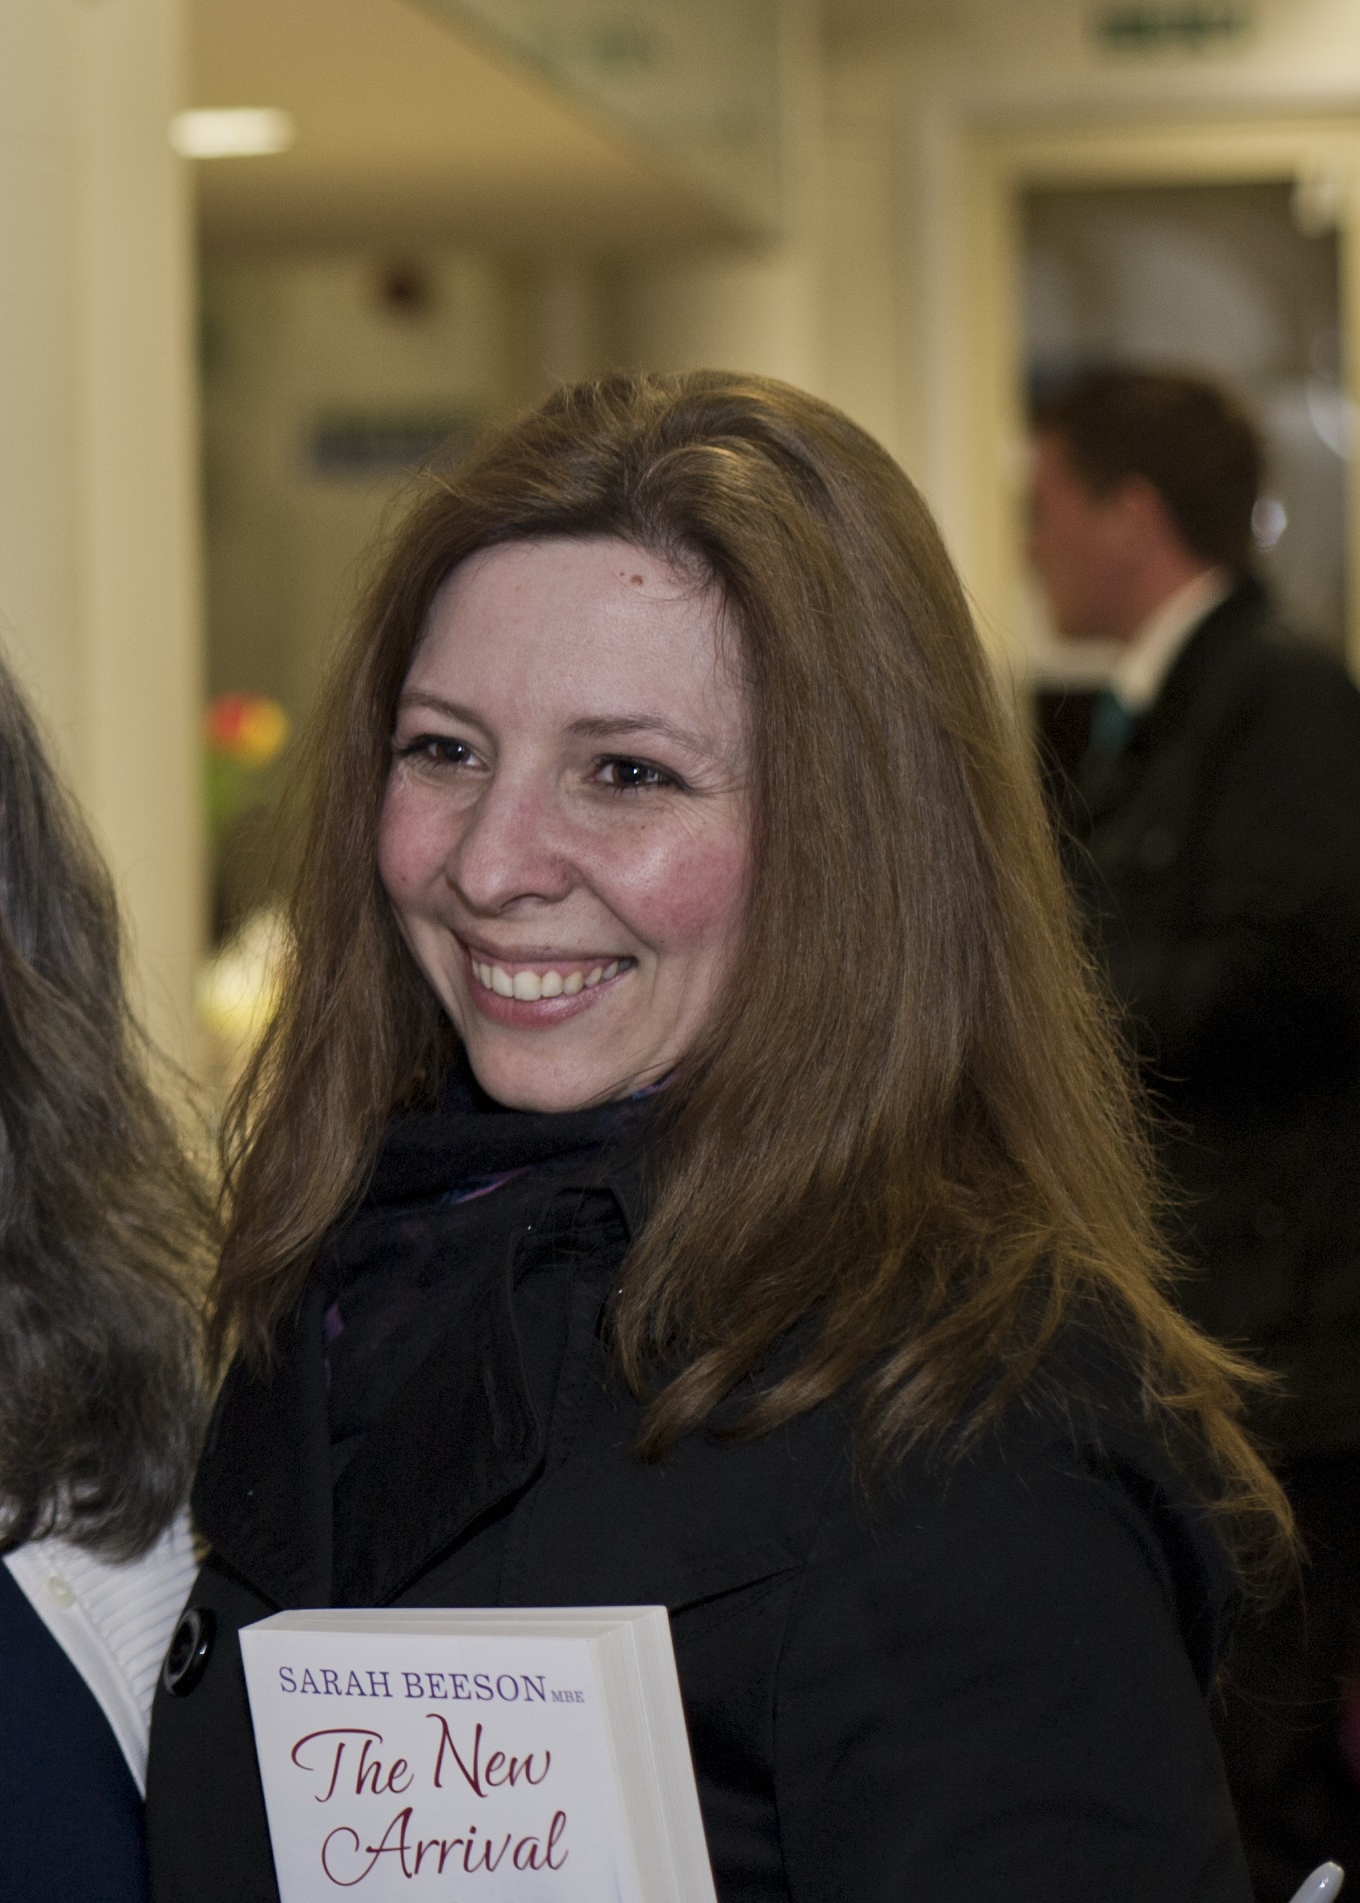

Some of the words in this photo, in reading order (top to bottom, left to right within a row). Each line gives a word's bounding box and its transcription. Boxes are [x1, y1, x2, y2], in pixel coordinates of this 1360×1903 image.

[278, 1666, 393, 1699] SARAH
[401, 1671, 547, 1703] BEESON
[550, 1690, 585, 1703] MBE
[291, 1728, 415, 1802] The
[425, 1713, 551, 1798] New
[321, 1806, 569, 1887] Arrival
